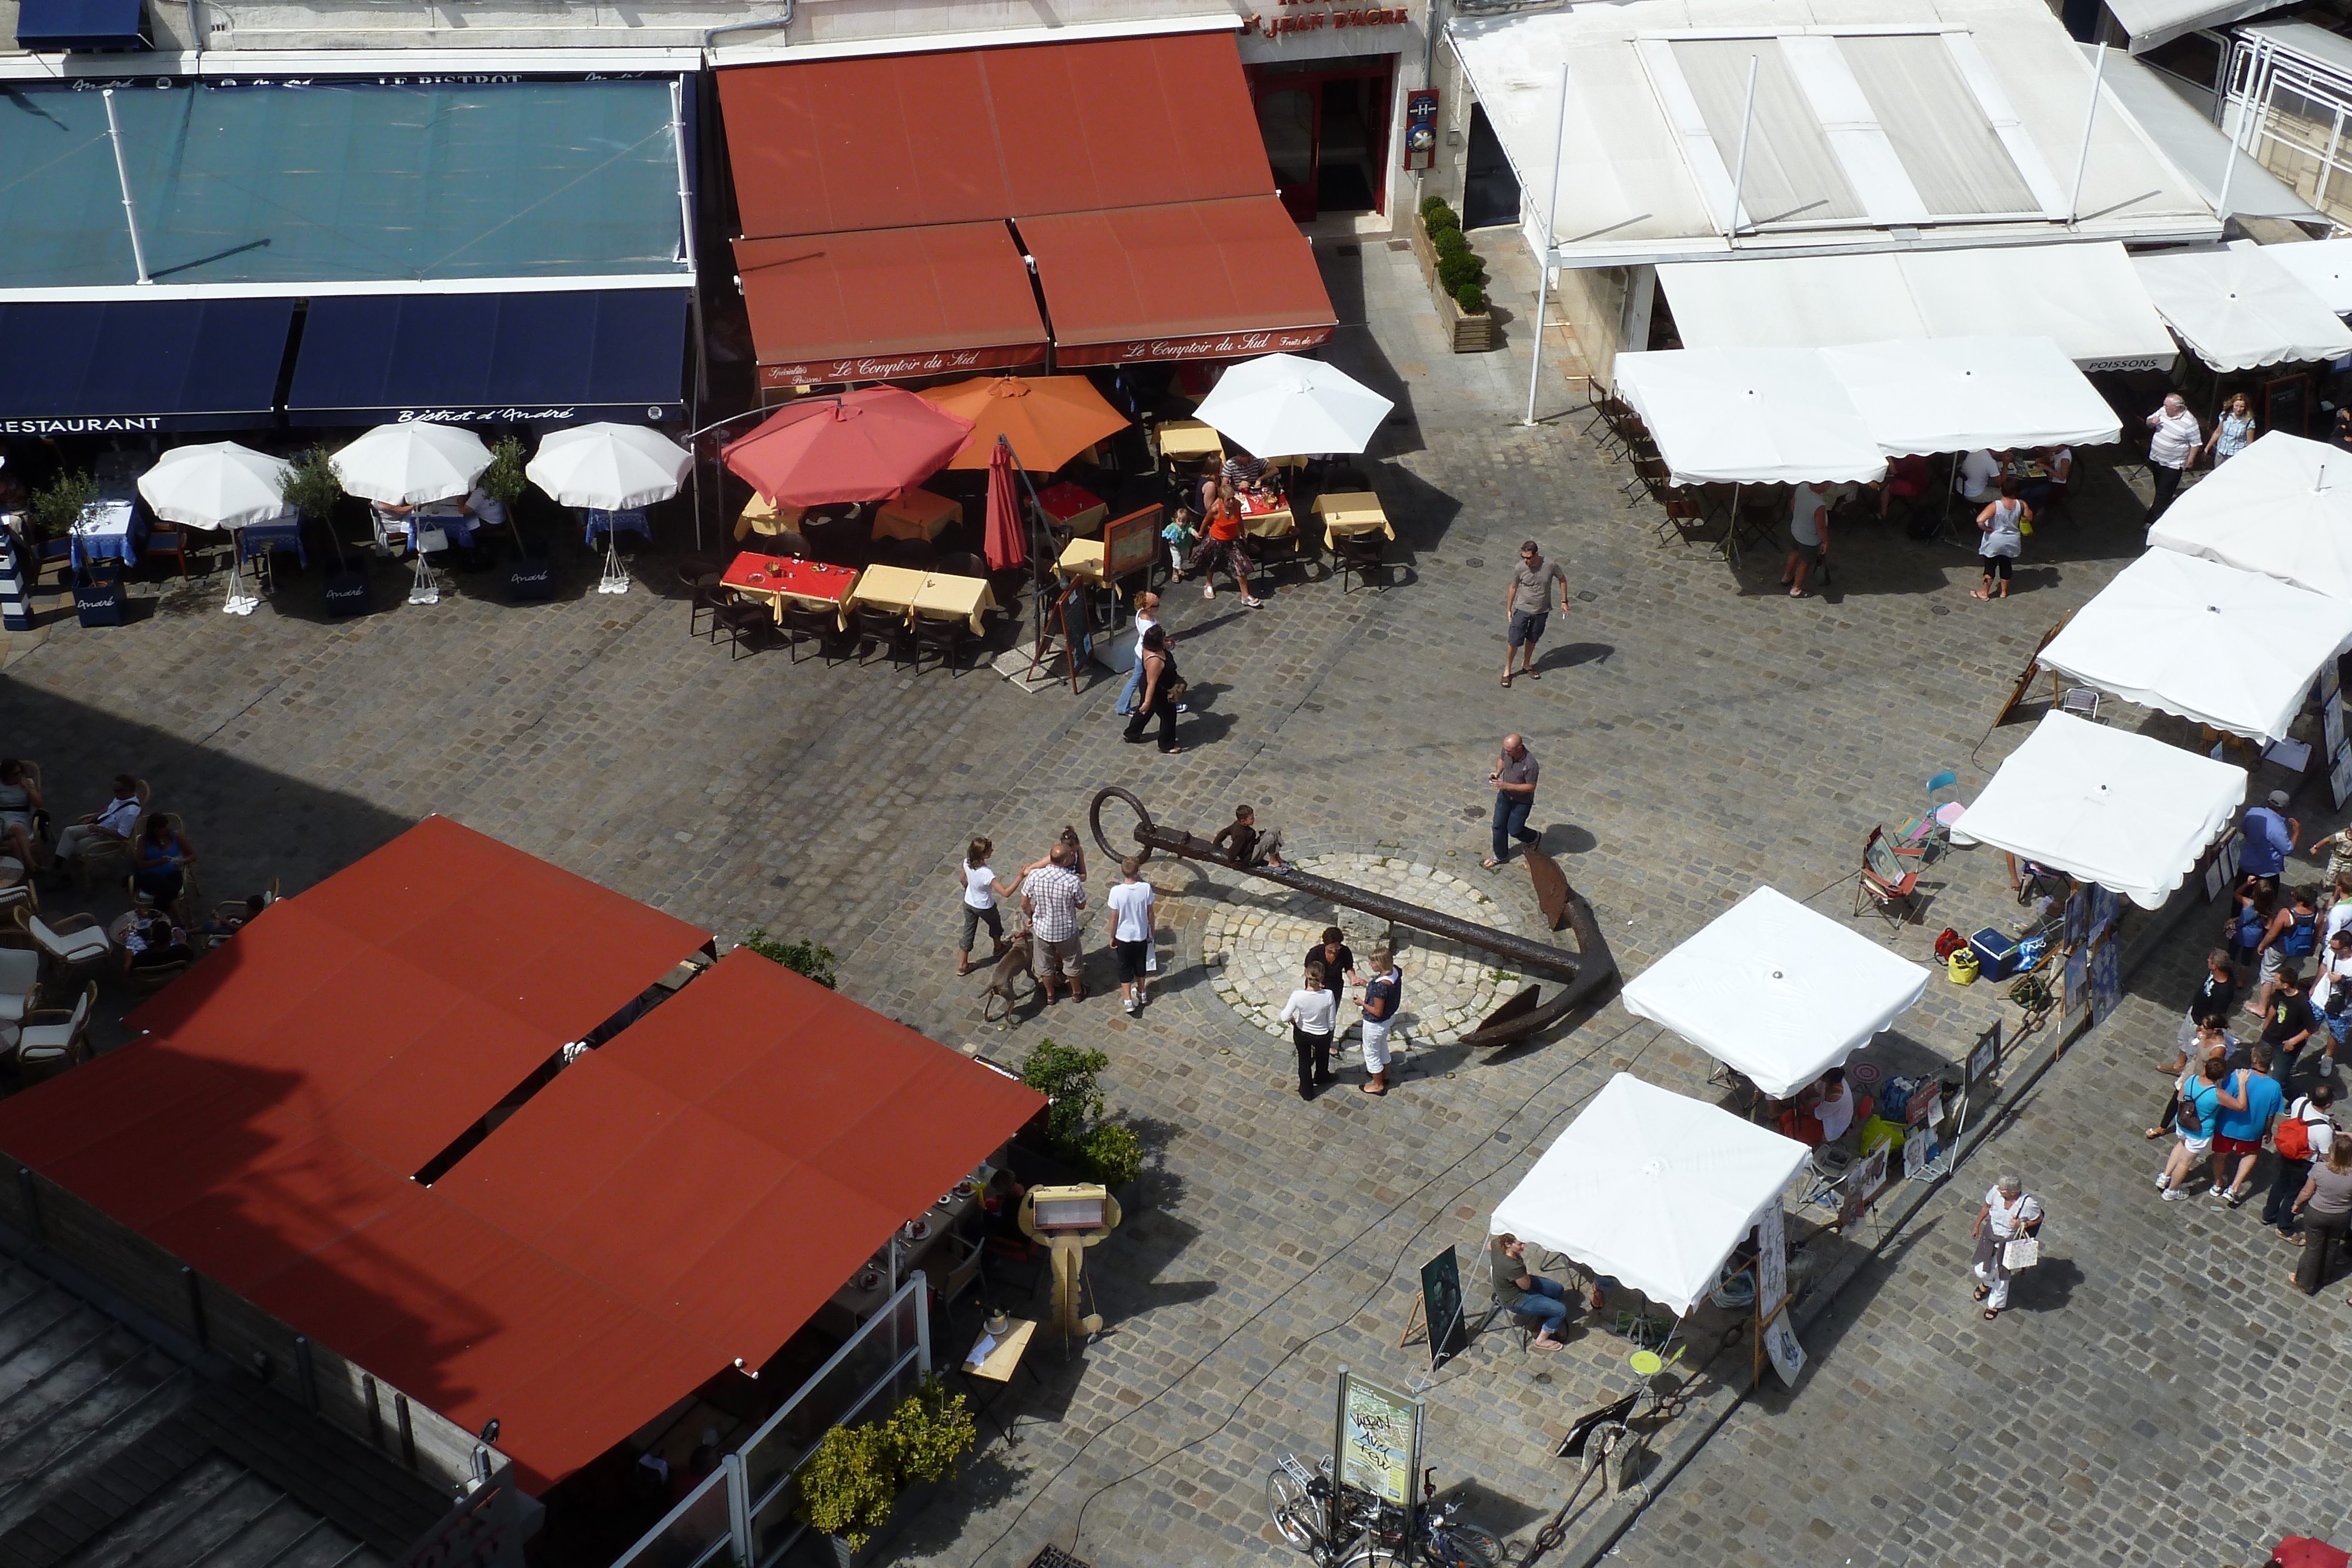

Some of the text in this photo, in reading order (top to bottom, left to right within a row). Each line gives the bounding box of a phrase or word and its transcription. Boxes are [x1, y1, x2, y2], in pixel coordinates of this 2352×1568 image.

[1265, 13, 1324, 38] JEAN
[1333, 6, 1408, 28] D'ACRE
[1418, 103, 1428, 115] H
[1122, 333, 1271, 358] Le Comptoir du Sud
[828, 350, 981, 377] Le Comptoir du Sud
[2089, 360, 2157, 369] POISSONS
[397, 407, 574, 423] Bistrot d'André
[511, 570, 548, 584] André
[326, 586, 363, 599] André
[77, 596, 115, 610] André
